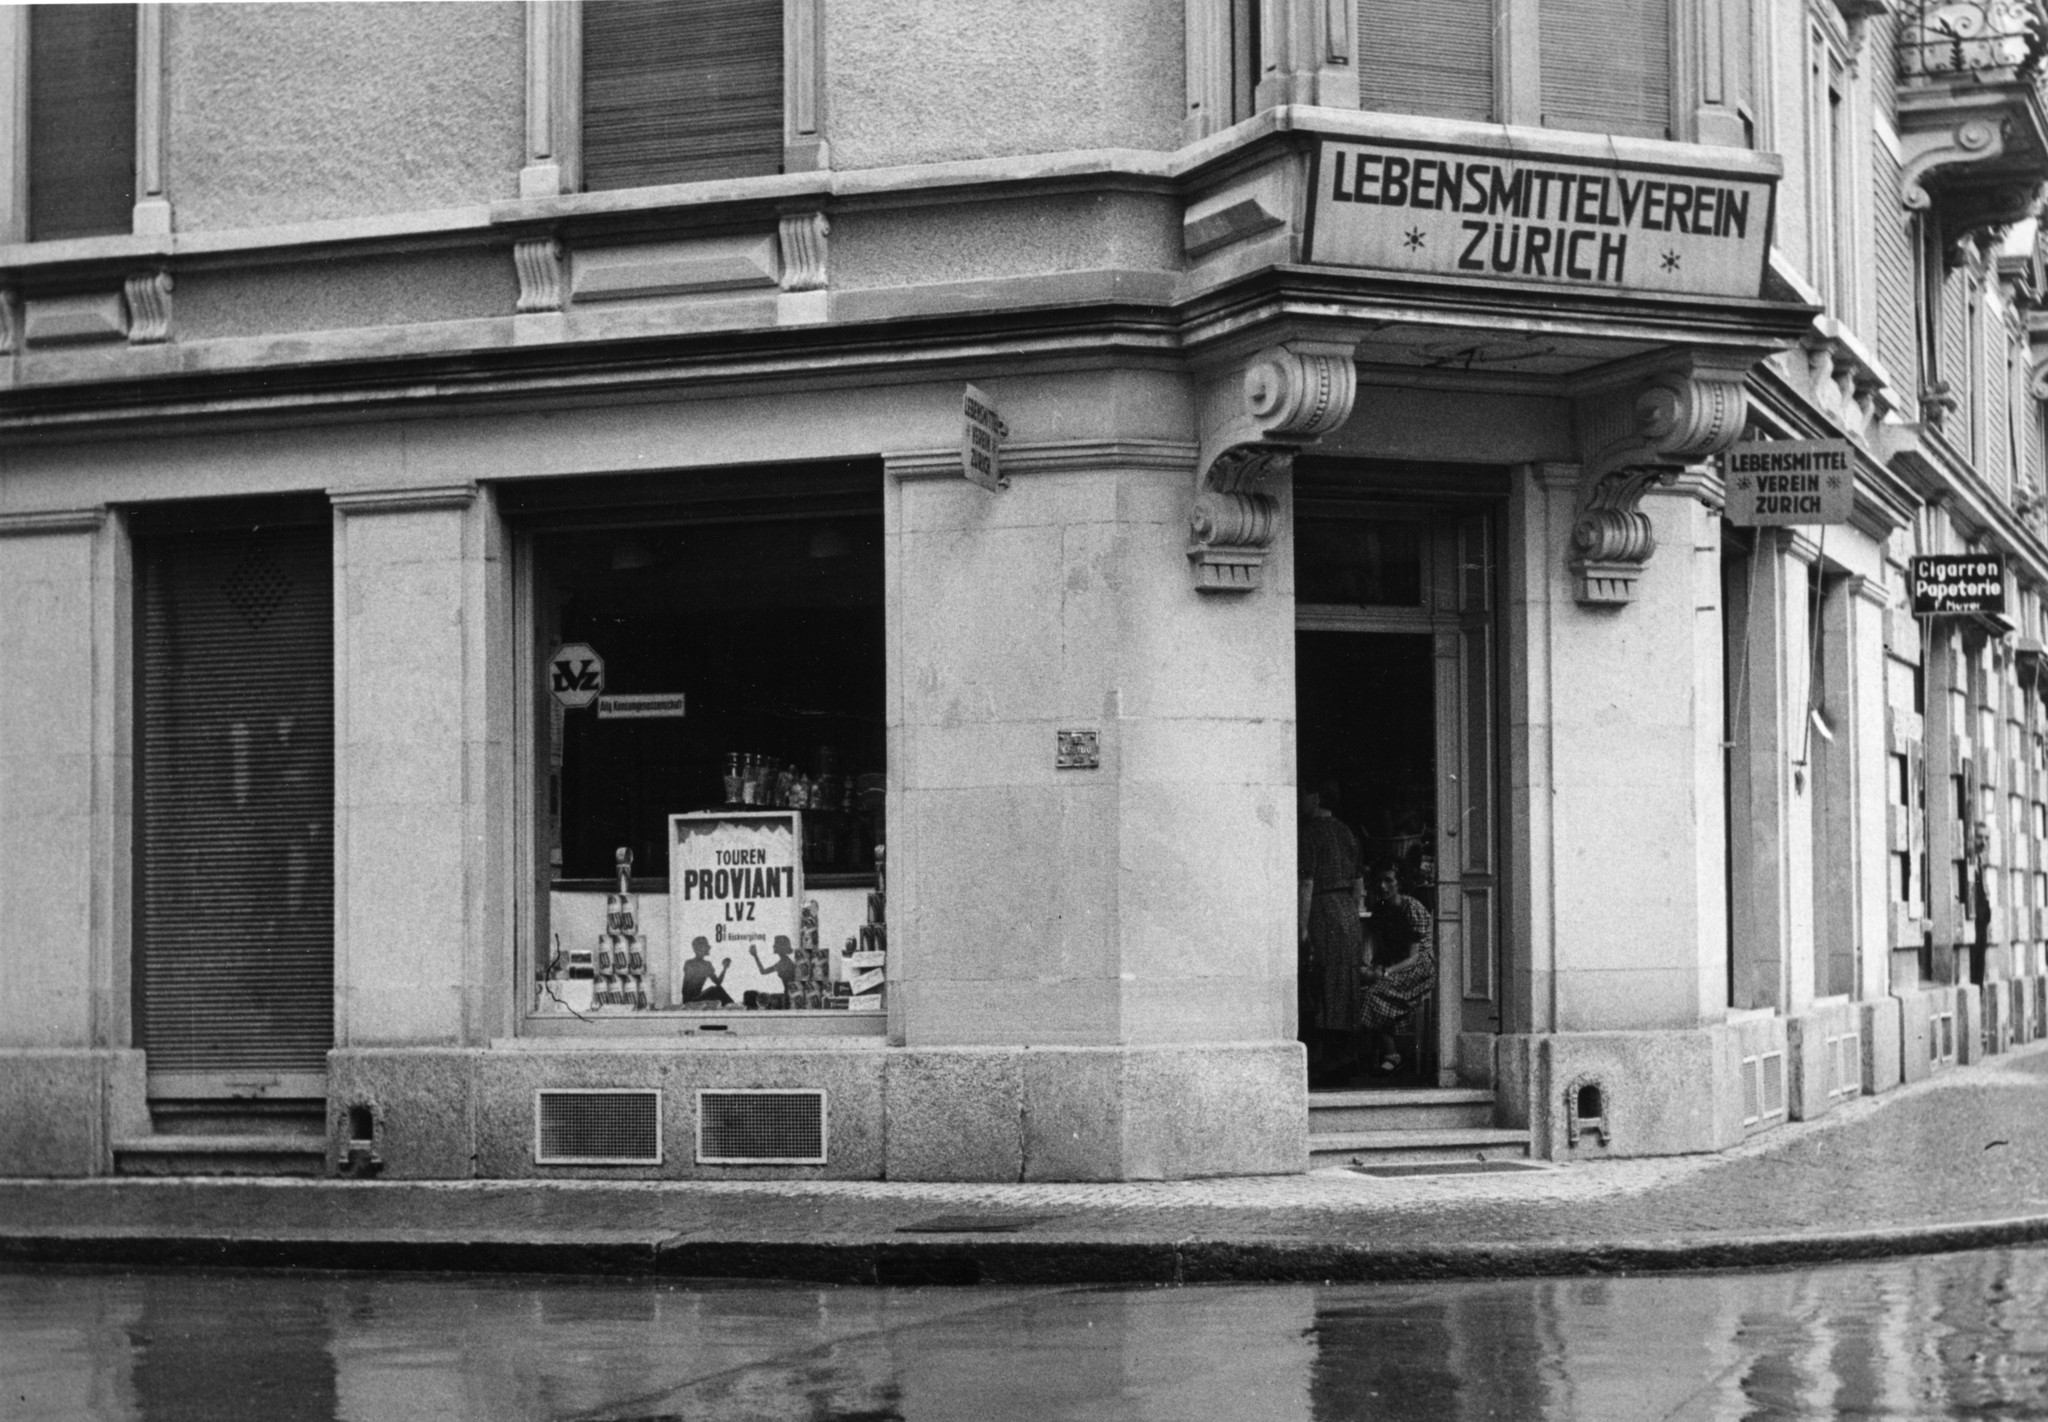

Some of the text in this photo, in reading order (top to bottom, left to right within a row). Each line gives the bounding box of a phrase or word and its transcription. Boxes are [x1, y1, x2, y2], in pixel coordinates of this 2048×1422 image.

[1332, 151, 1750, 239] LEBENSMITTELVEREIN
[1458, 219, 1628, 282] ZÜRICH
[1731, 452, 1848, 473] LEBENSMITTEL
[1756, 475, 1820, 493] VEREIN
[1918, 560, 1999, 582] Cigarren
[1916, 579, 2002, 601] Papeterie
[715, 848, 767, 866] TOUREN
[684, 866, 794, 901] PROVIANT
[725, 901, 756, 922] LVZ
